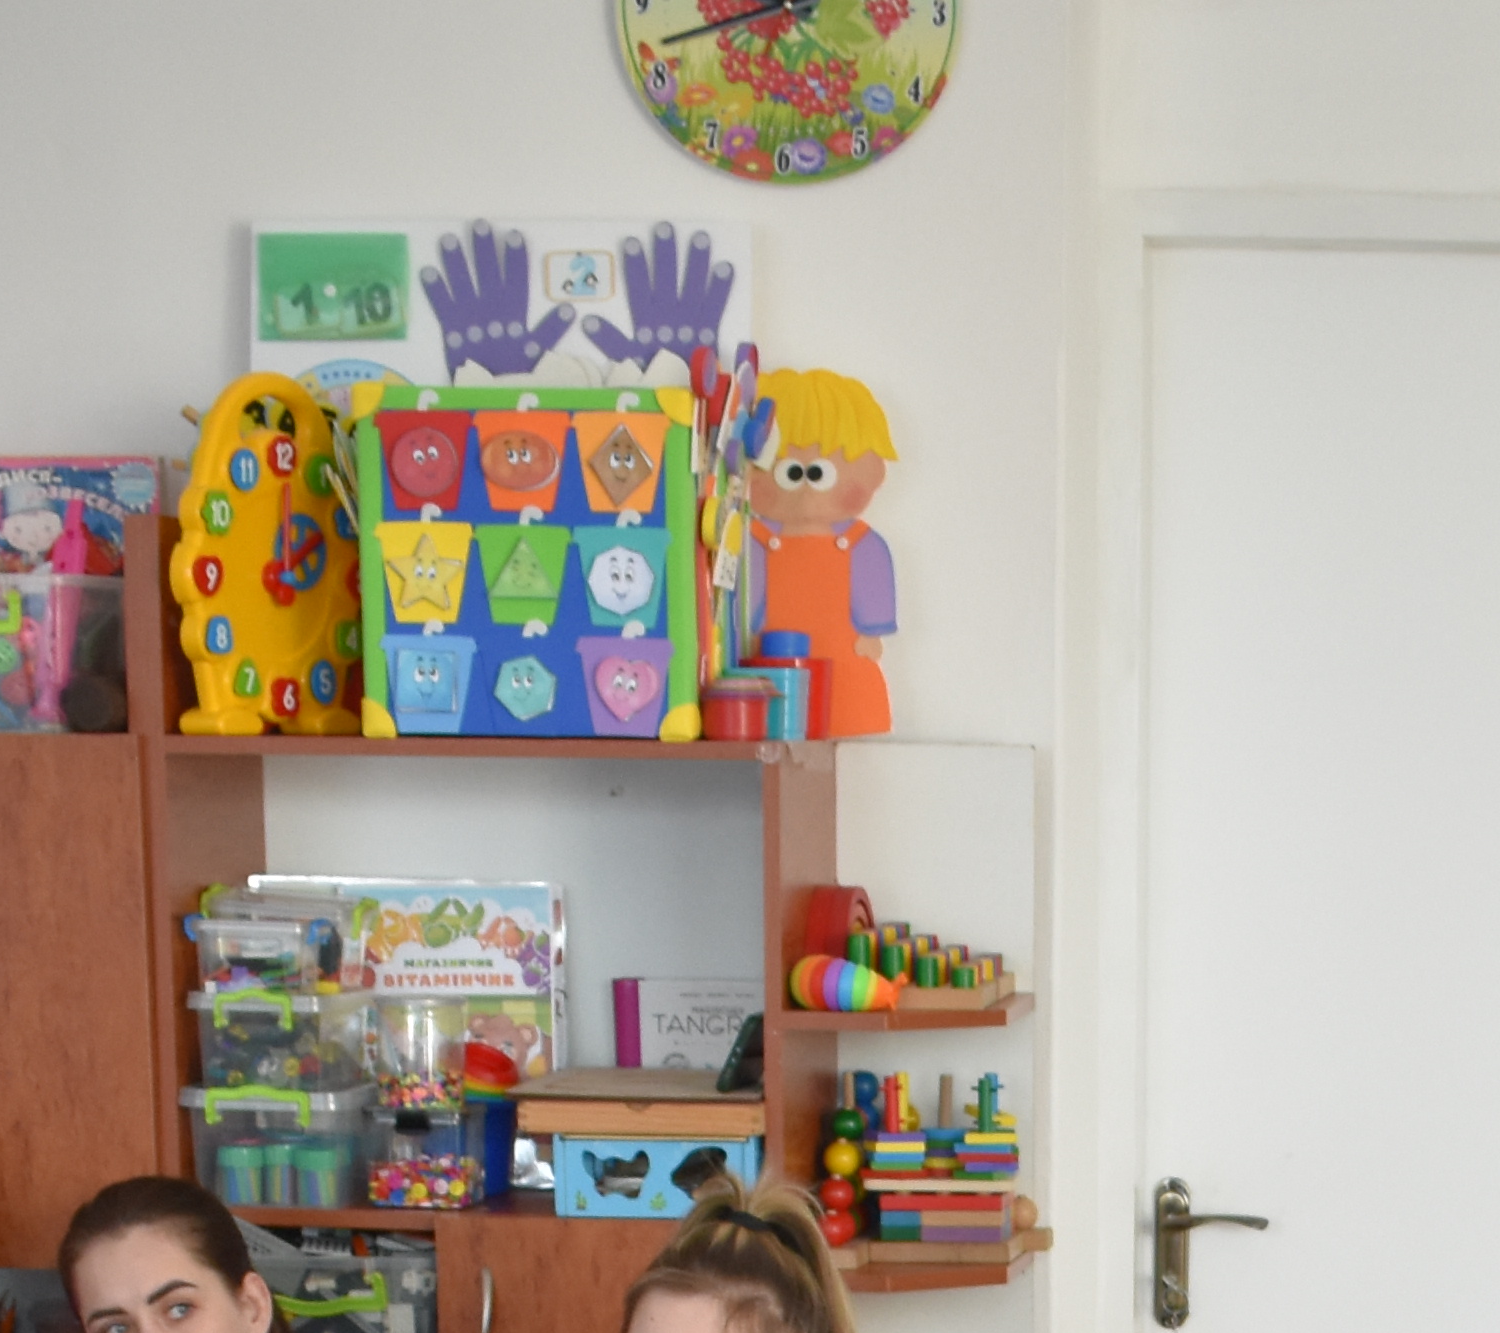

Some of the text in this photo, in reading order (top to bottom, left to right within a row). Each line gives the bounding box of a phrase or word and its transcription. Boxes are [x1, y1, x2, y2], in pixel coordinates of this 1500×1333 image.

[652, 62, 667, 91] 8
[907, 76, 922, 103] 4
[705, 123, 719, 150] 7
[852, 129, 868, 158] 5
[776, 145, 790, 174] 6
[568, 254, 597, 295] 2
[239, 456, 255, 483] 11
[274, 442, 294, 470] 12
[211, 500, 229, 526] 10
[204, 564, 218, 590] 9
[216, 623, 227, 650] 8
[243, 666, 255, 693] 7
[320, 669, 332, 695] 5
[283, 683, 296, 710] 6
[384, 974, 514, 988] ВІТАМІНЧИК
[652, 1013, 744, 1036] TANGR
